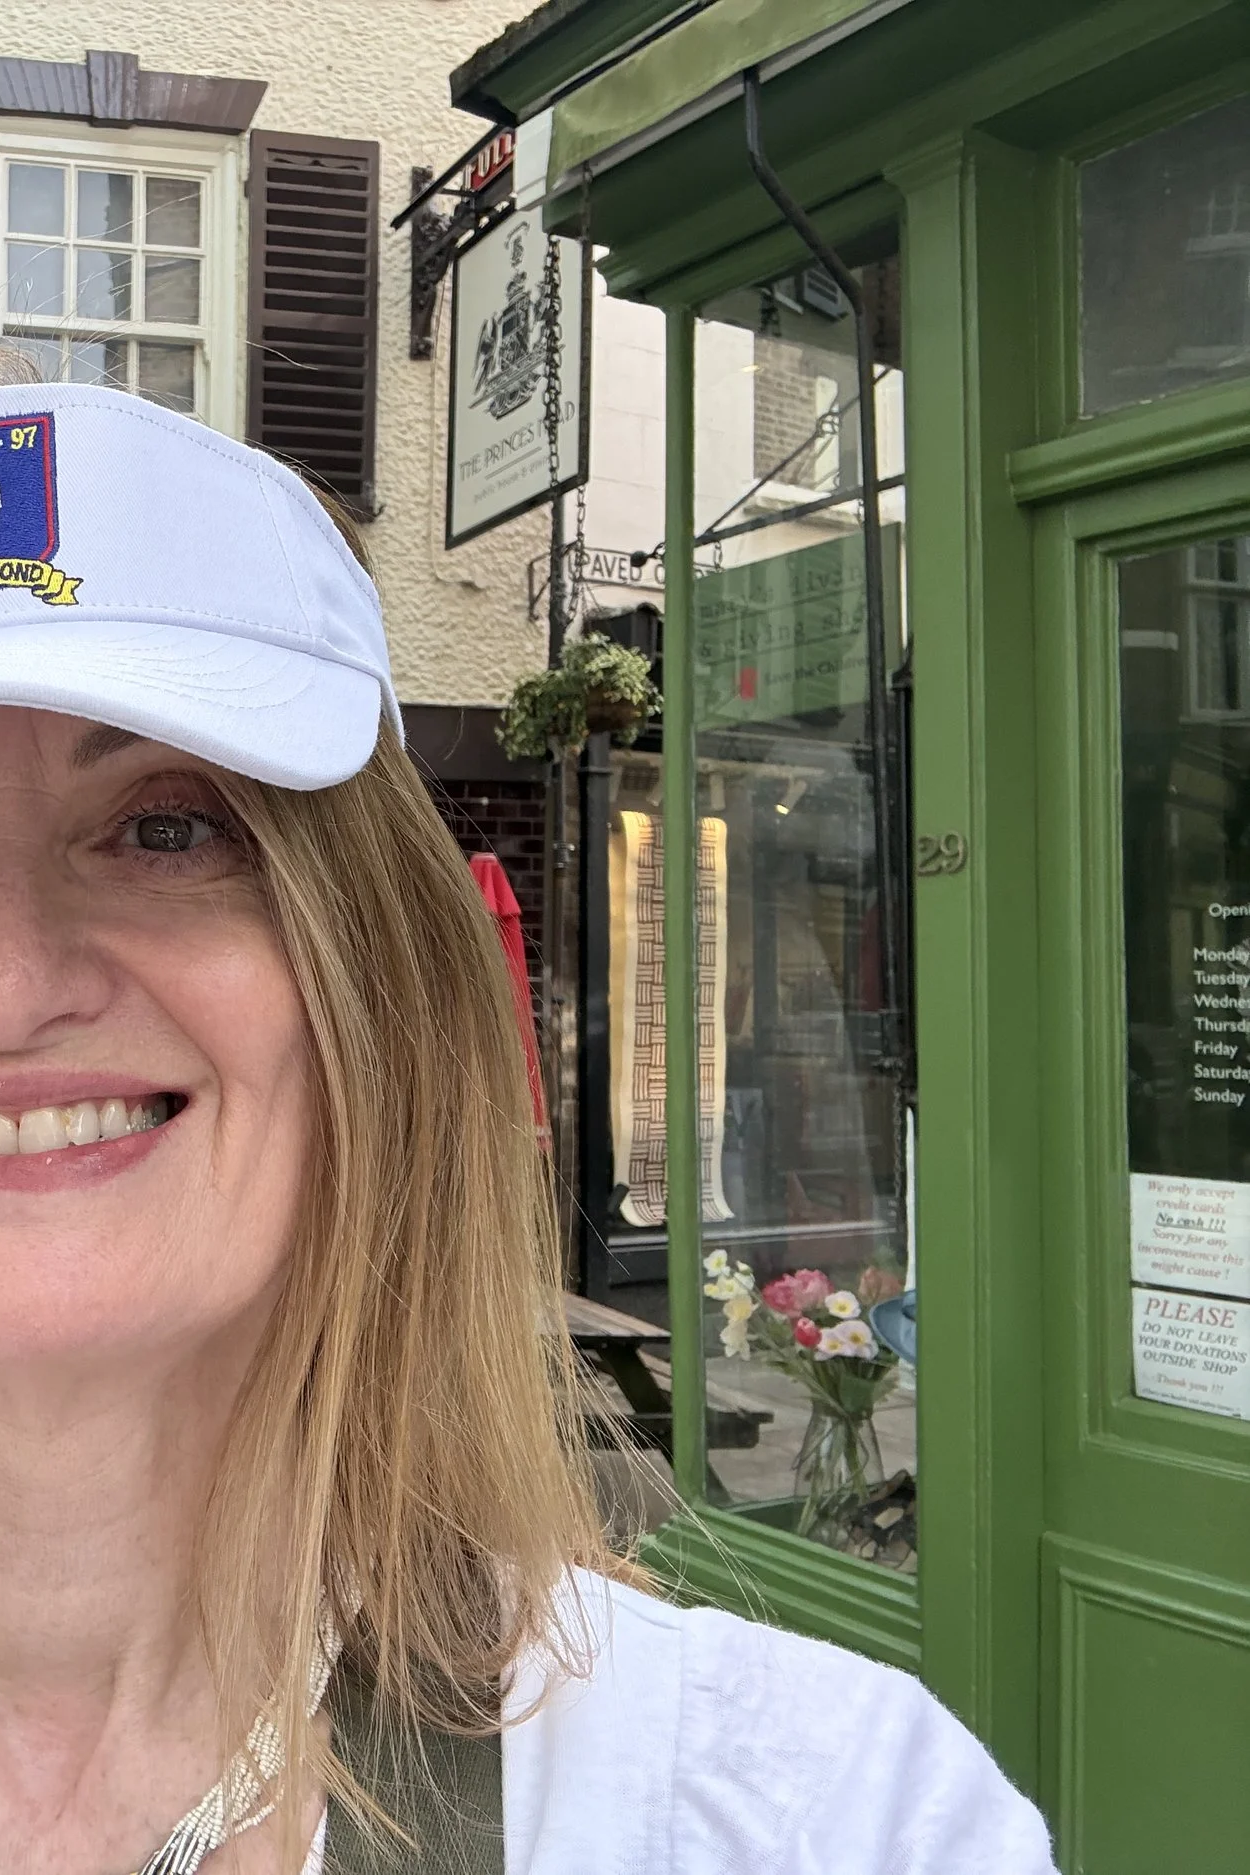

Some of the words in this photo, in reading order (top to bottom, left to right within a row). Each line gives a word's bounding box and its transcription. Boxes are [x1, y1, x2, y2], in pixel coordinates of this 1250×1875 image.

[11, 425, 37, 449] 97
[917, 832, 964, 873] 29
[1193, 946, 1249, 965] Monday
[1194, 1040, 1239, 1060] Friday
[1194, 1086, 1246, 1107] Sunday
[1156, 1200, 1190, 1210] credit
[1156, 1212, 1174, 1225] No
[1177, 1217, 1204, 1228] cash
[1152, 1227, 1183, 1243] Sorry
[1183, 1234, 1205, 1246] for
[1222, 1253, 1245, 1266] this
[1143, 1297, 1238, 1329] PLEASE
[1141, 1321, 1162, 1333] DO
[1166, 1325, 1194, 1340] NOT
[1197, 1331, 1239, 1347] LEAVE
[1137, 1334, 1171, 1349] YOUR
[1173, 1341, 1248, 1364] DONATIONS
[1142, 1350, 1198, 1369] OUTSIDE
[1201, 1360, 1238, 1376] SHOP
